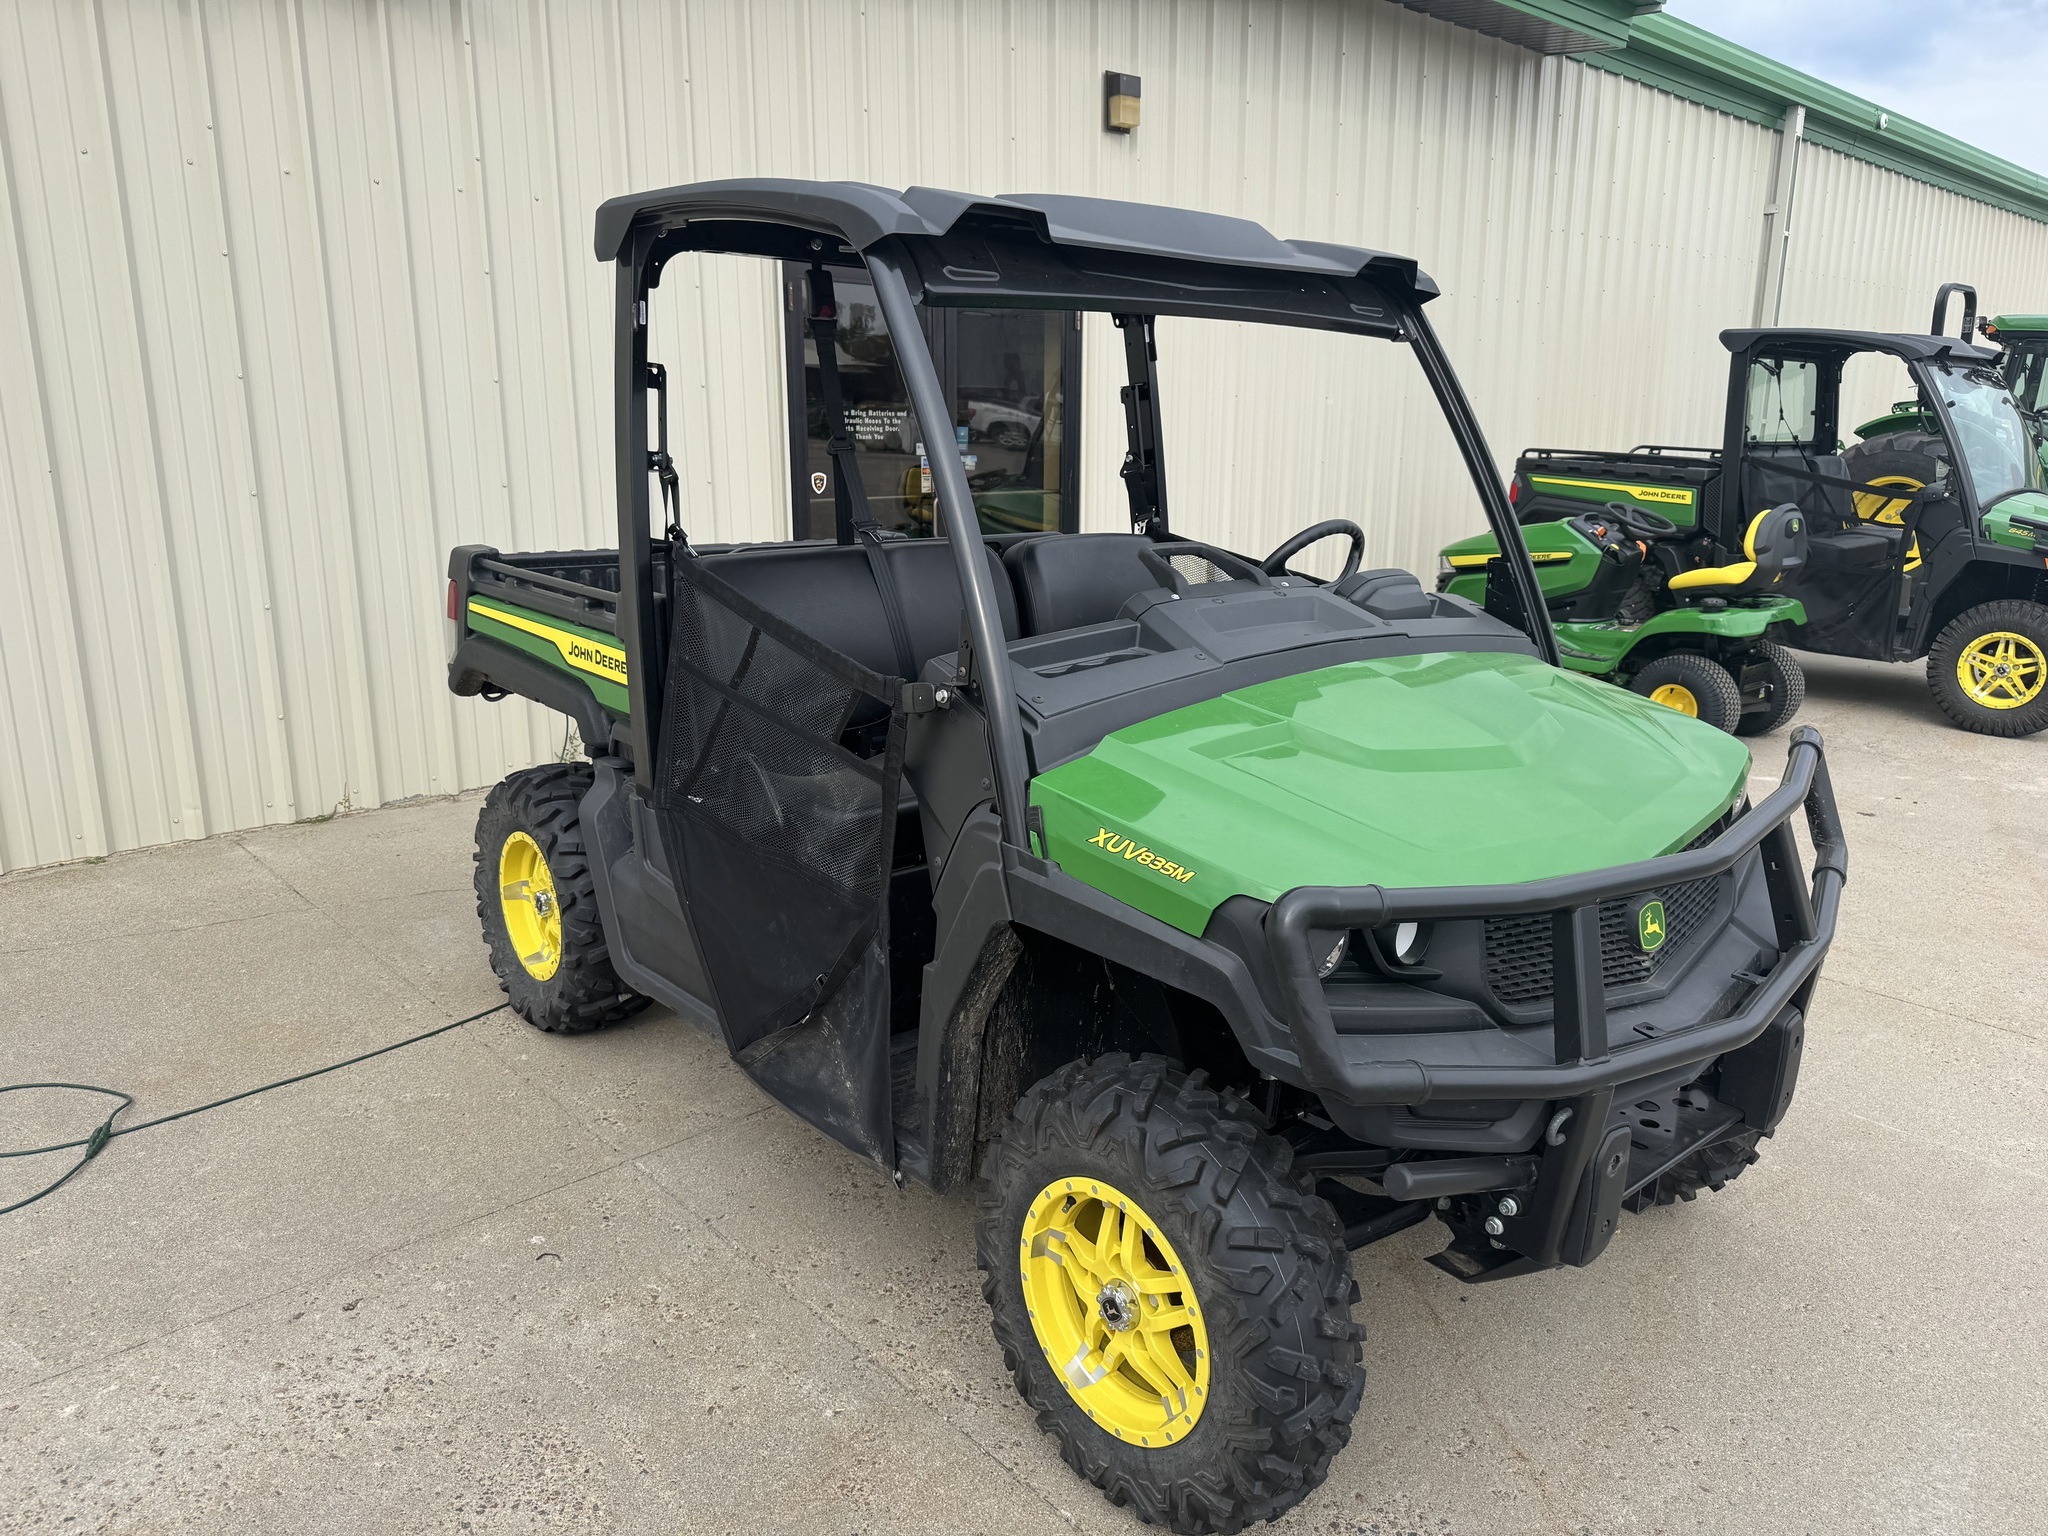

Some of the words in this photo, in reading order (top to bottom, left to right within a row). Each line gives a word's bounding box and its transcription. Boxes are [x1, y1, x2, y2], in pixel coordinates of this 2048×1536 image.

[850, 409, 867, 417] Bring
[868, 409, 895, 417] Batteries
[855, 425, 884, 433] Receiving
[1638, 490, 1659, 498] JOHN
[1660, 491, 1687, 500] DEERE
[568, 641, 593, 663] JOHN
[595, 649, 627, 675] DEERE
[1086, 827, 1197, 884] XUV835M
